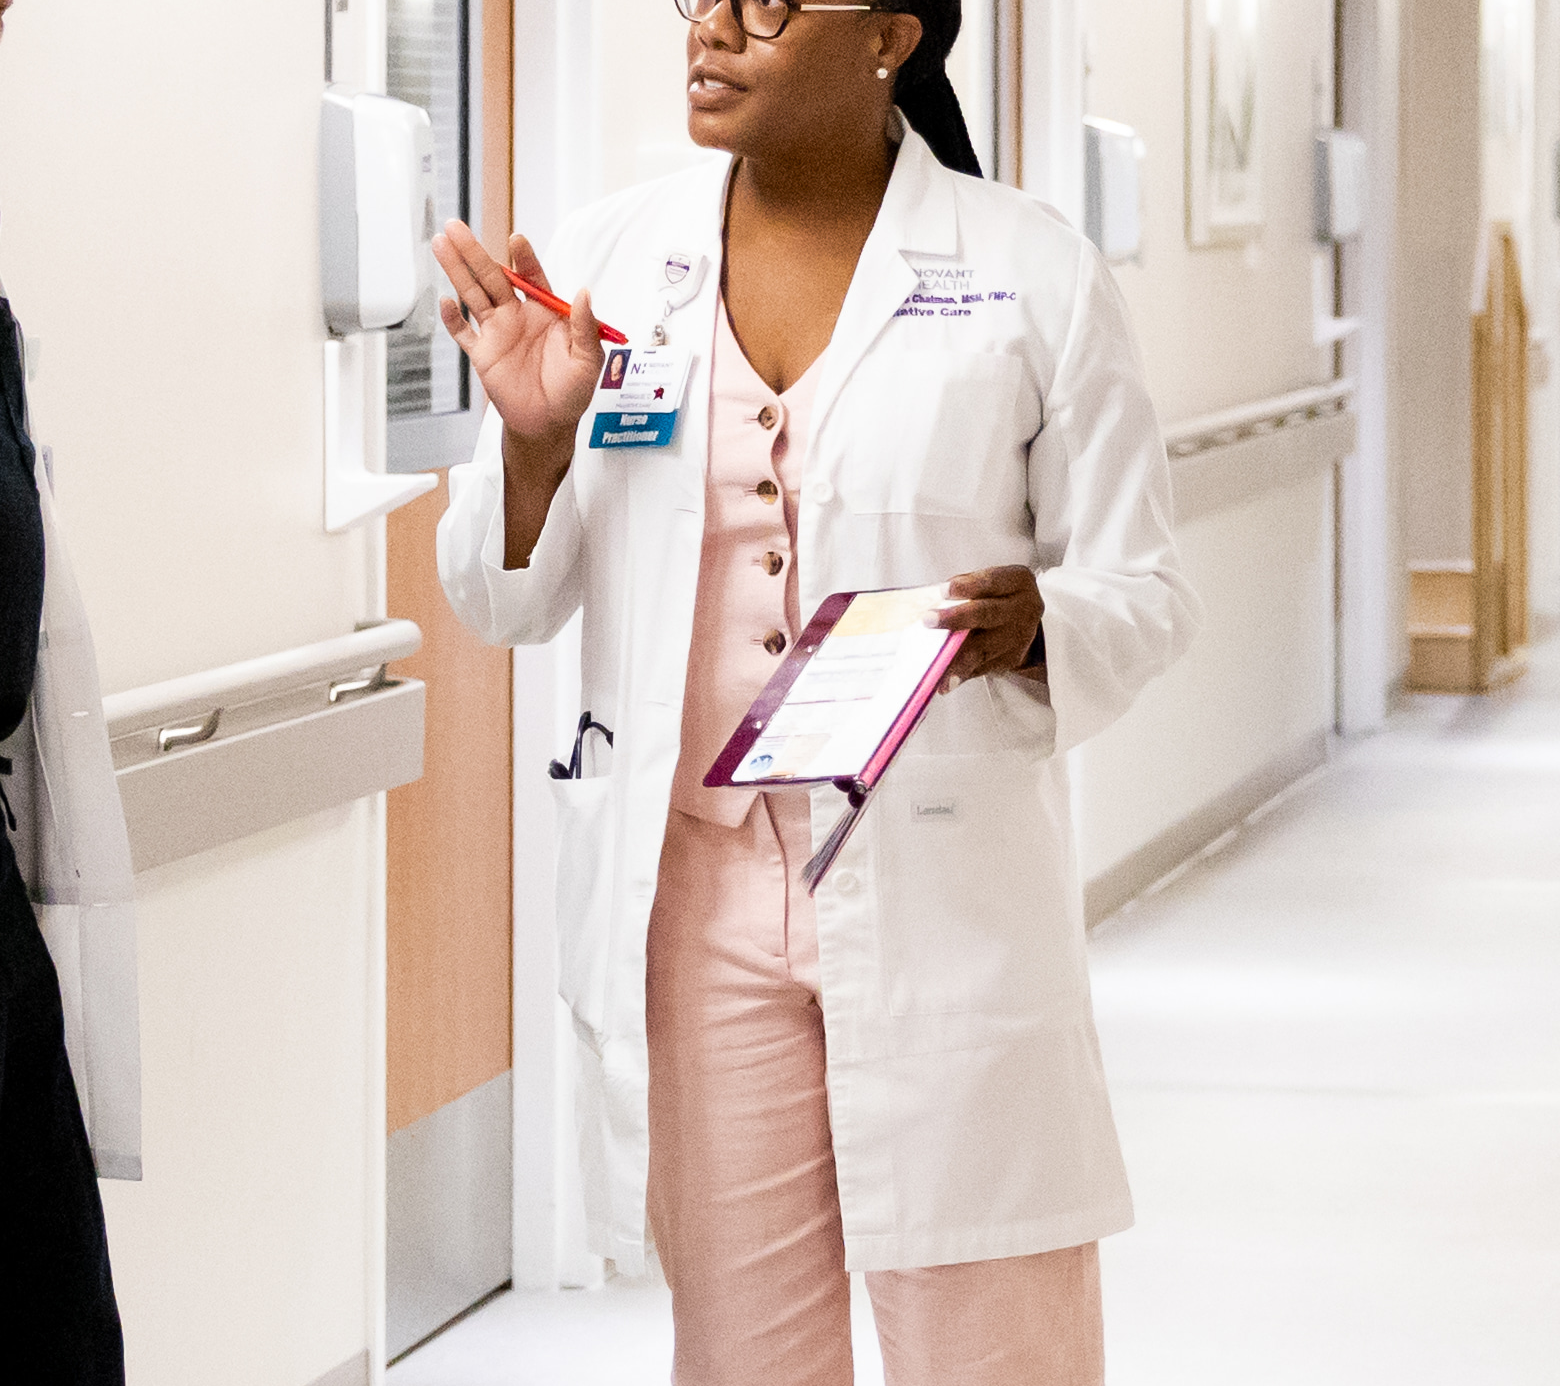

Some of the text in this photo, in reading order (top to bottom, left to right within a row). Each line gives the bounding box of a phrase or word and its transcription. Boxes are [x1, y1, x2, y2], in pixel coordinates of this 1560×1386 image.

[940, 308, 971, 317] Care
[620, 414, 648, 426] Nurse
[602, 430, 659, 444] Practitioner
